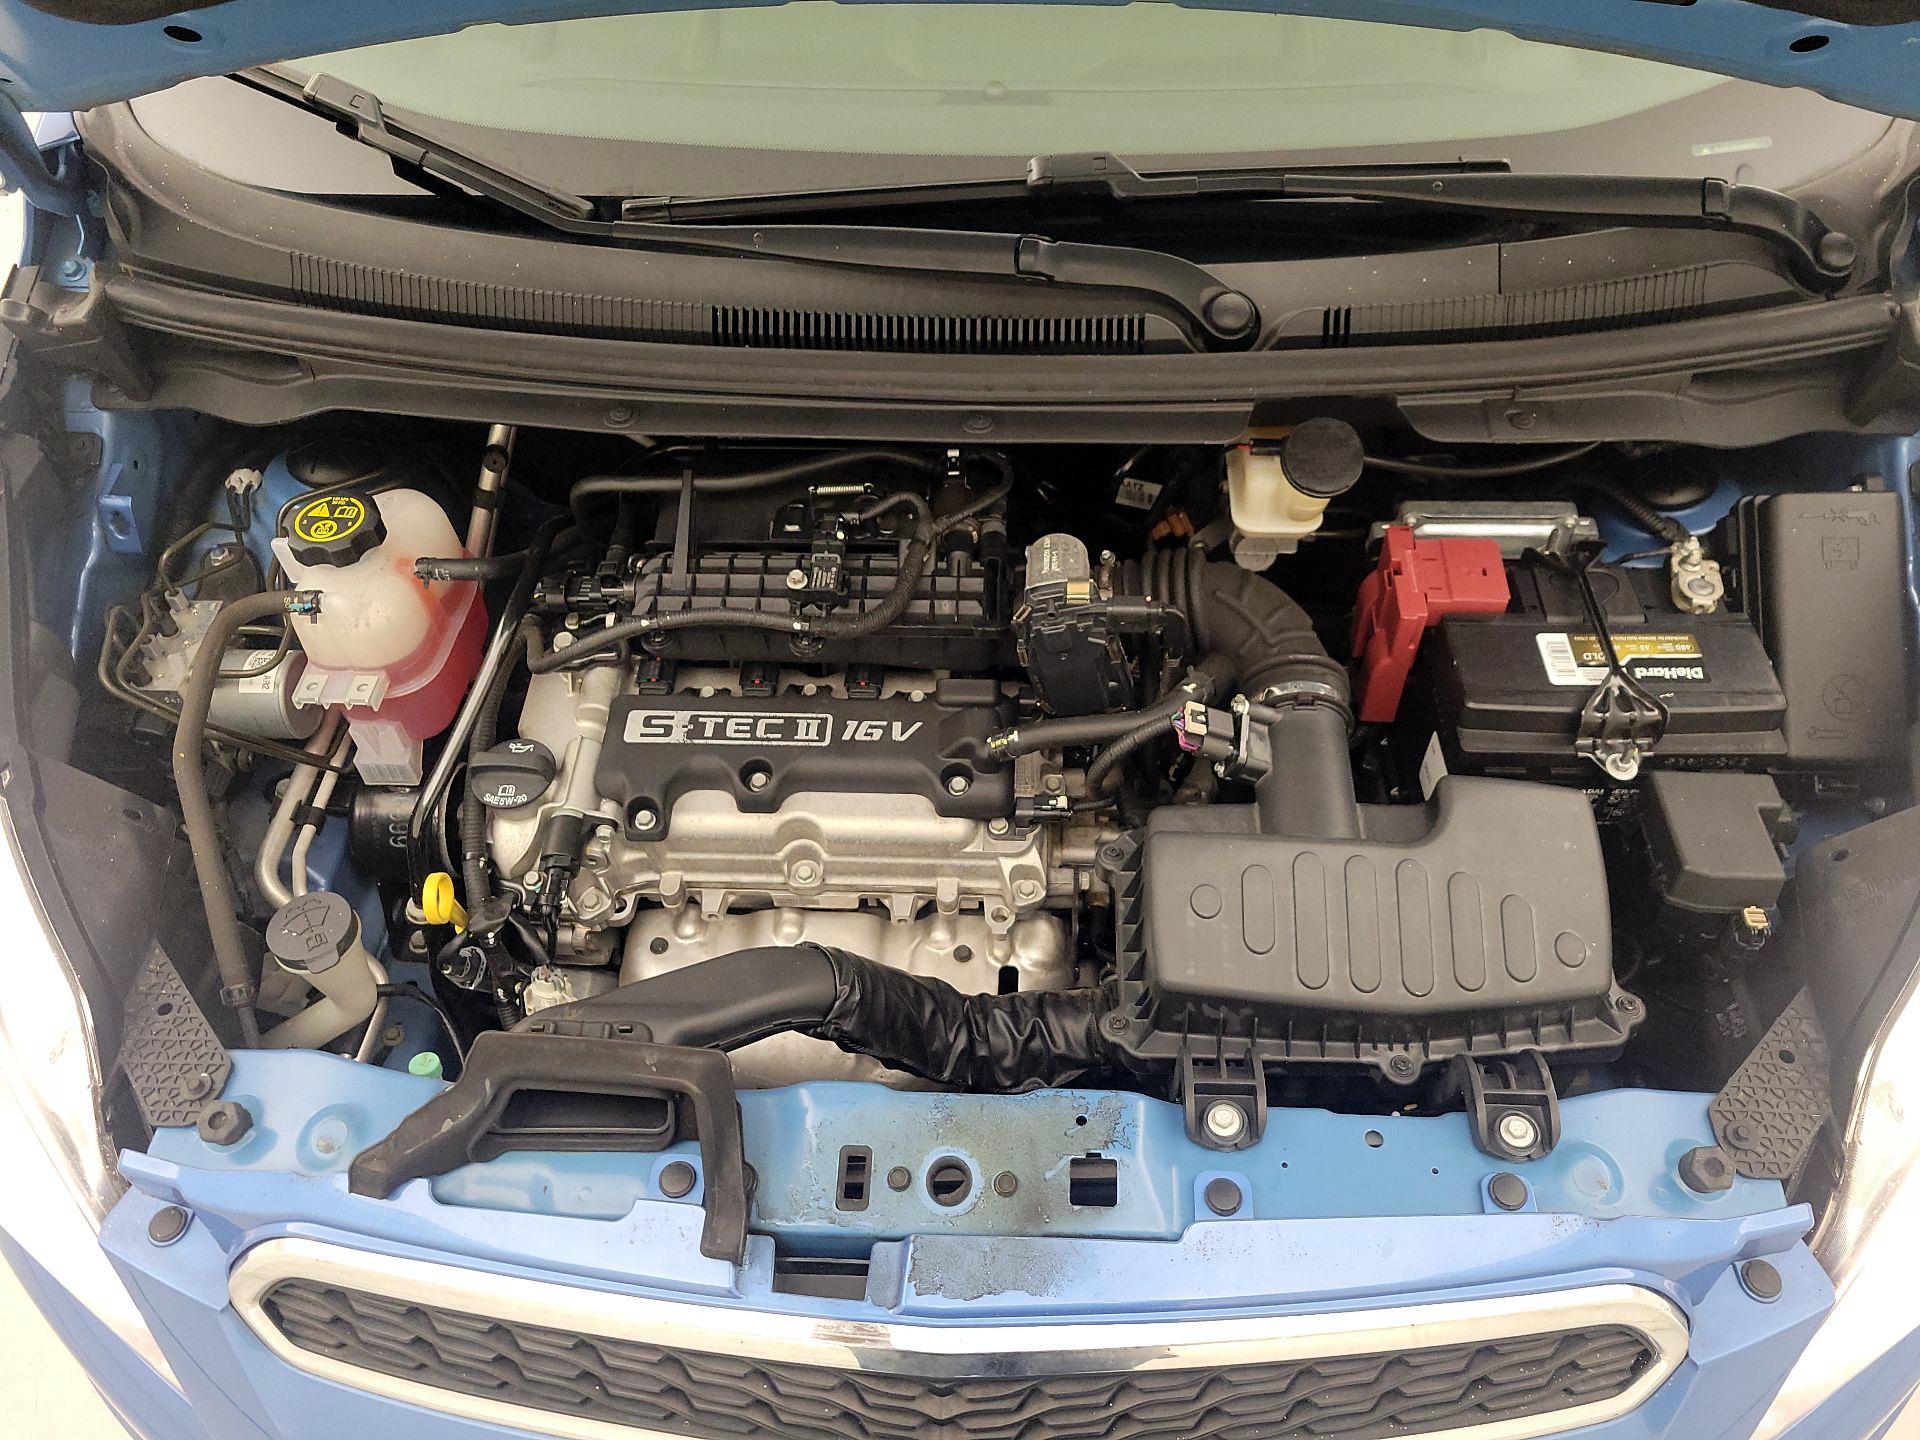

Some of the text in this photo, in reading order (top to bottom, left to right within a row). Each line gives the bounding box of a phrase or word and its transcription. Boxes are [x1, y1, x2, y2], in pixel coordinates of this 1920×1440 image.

[1582, 652, 1606, 661] OLD
[1634, 666, 1704, 680] DieHard
[841, 720, 924, 742] 16V
